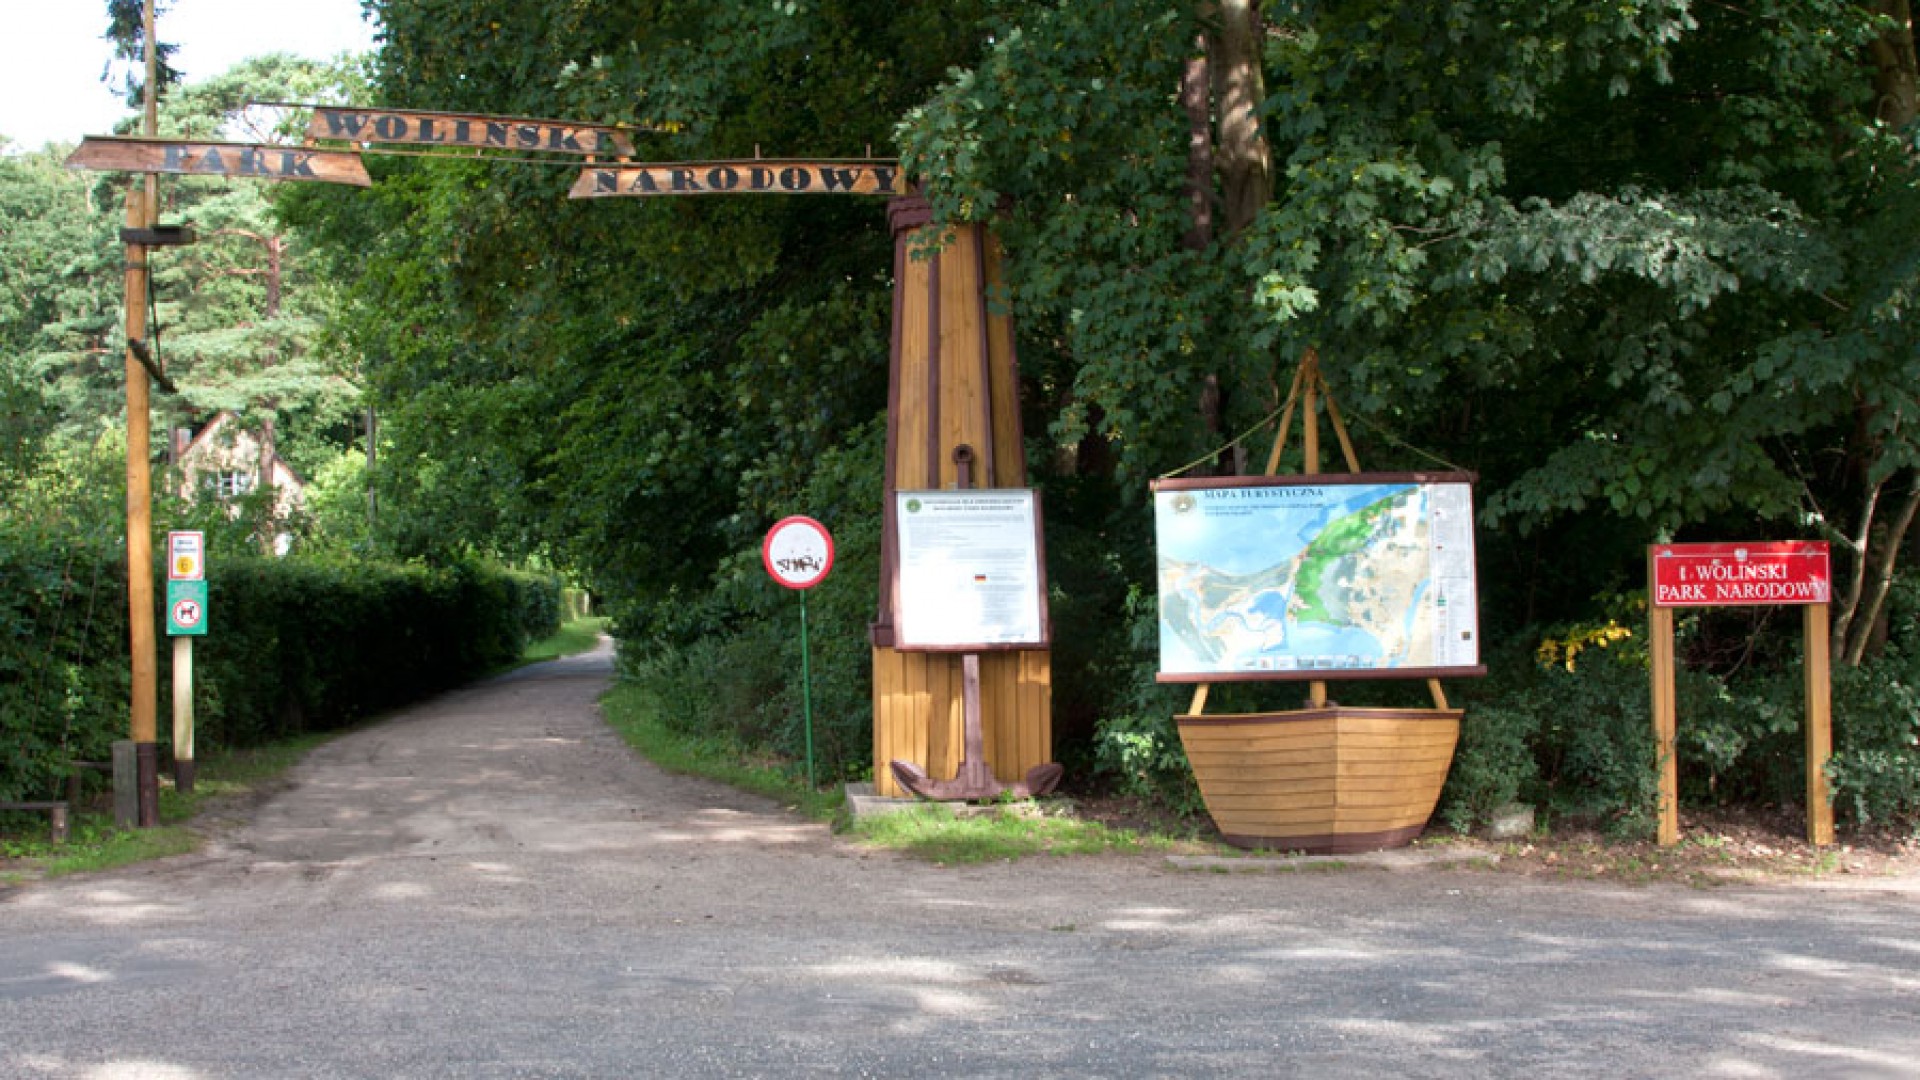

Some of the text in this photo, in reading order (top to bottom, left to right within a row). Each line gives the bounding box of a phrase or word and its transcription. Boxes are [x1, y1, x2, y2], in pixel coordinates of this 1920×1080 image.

[163, 145, 319, 177] PARK
[592, 166, 897, 193] NARODOWY
[1204, 490, 1236, 499] MAPA
[1659, 582, 1821, 600] PARK NARODOWY
